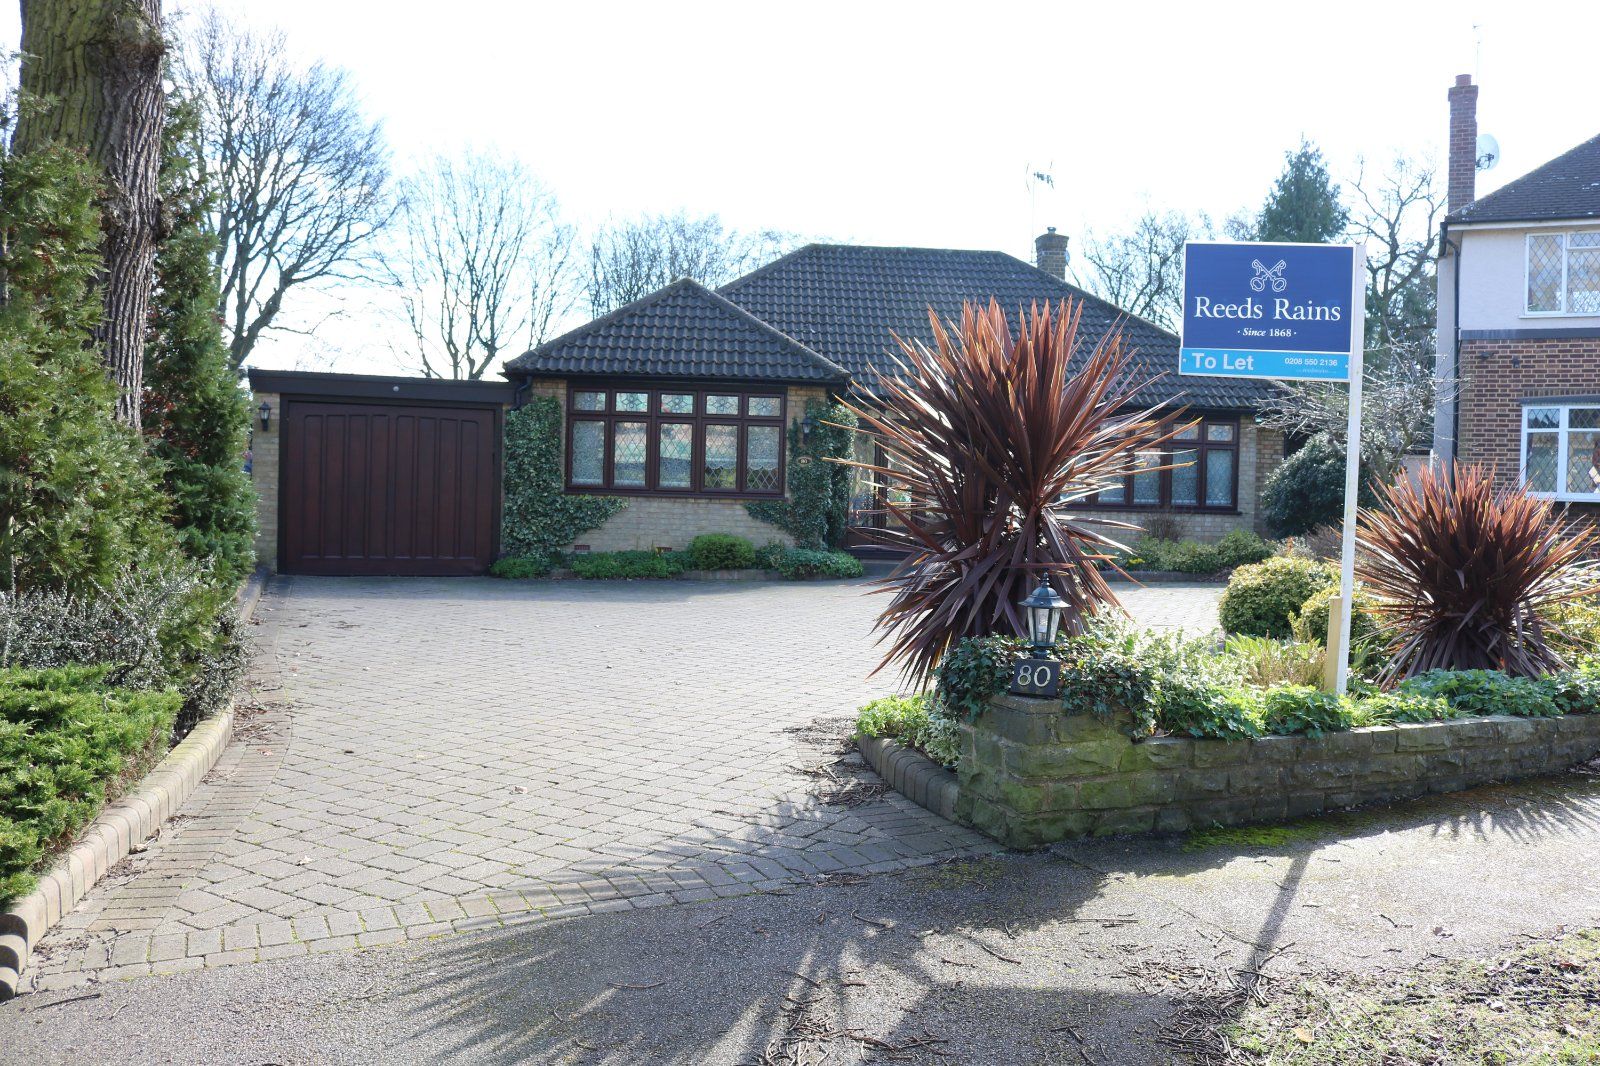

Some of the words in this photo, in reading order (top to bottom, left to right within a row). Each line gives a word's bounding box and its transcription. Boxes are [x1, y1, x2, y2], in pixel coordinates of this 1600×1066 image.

[1194, 296, 1263, 319] Reeds
[1273, 297, 1341, 321] Rains
[1242, 327, 1267, 337] Since
[1269, 328, 1292, 338] 1868
[1191, 352, 1217, 369] To
[1223, 353, 1255, 371] Let
[1284, 357, 1303, 365] 0208
[1304, 358, 1318, 366] 550
[1319, 359, 1338, 367] 2136
[1017, 664, 1051, 688] 80
